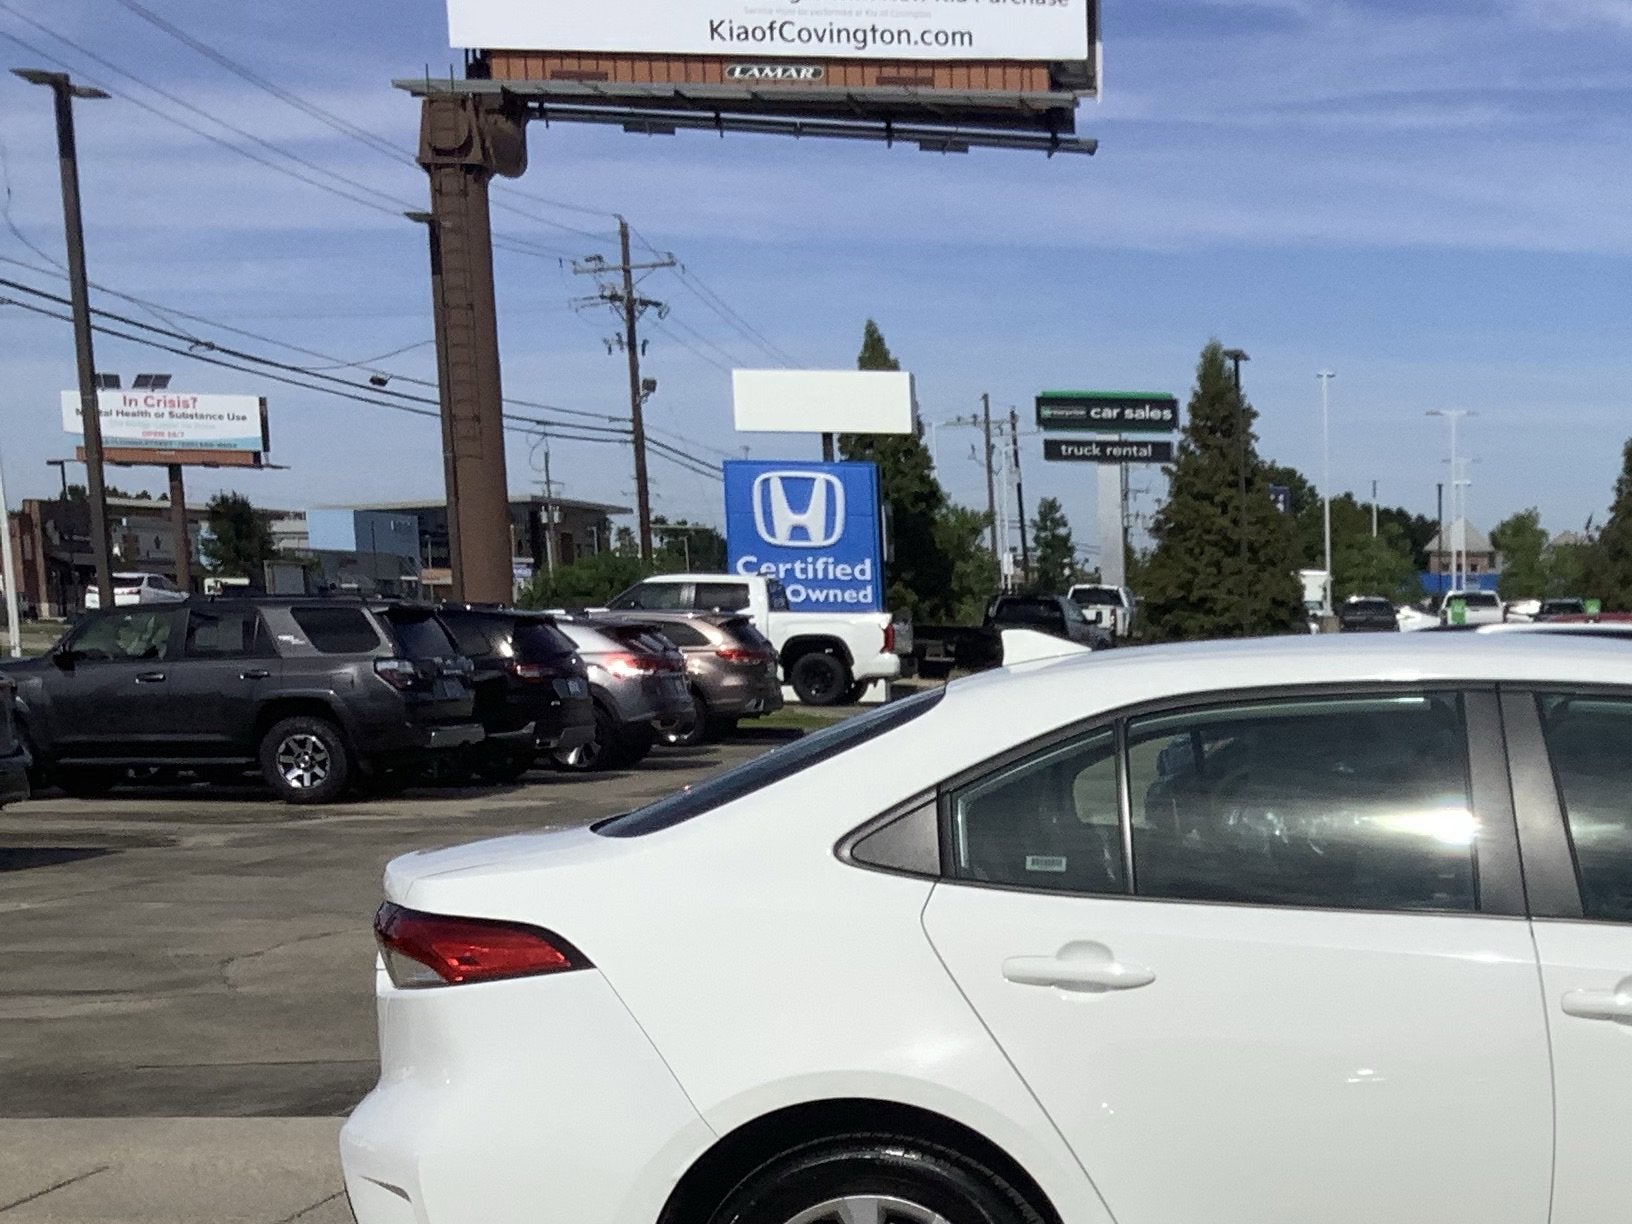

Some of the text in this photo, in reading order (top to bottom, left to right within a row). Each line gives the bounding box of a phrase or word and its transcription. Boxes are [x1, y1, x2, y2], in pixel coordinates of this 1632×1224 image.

[709, 19, 973, 50] KiaofCovington.com
[733, 65, 815, 79] LAMAR
[122, 395, 199, 410] In Crisis?
[116, 409, 152, 419] Health
[154, 411, 165, 420] or
[168, 410, 225, 422] Substance
[227, 412, 248, 422] Use
[1090, 407, 1122, 420] car
[1123, 404, 1173, 421] sales
[1060, 443, 1152, 458] truck rental
[736, 555, 872, 581] Certified
[785, 584, 873, 604] Owned
